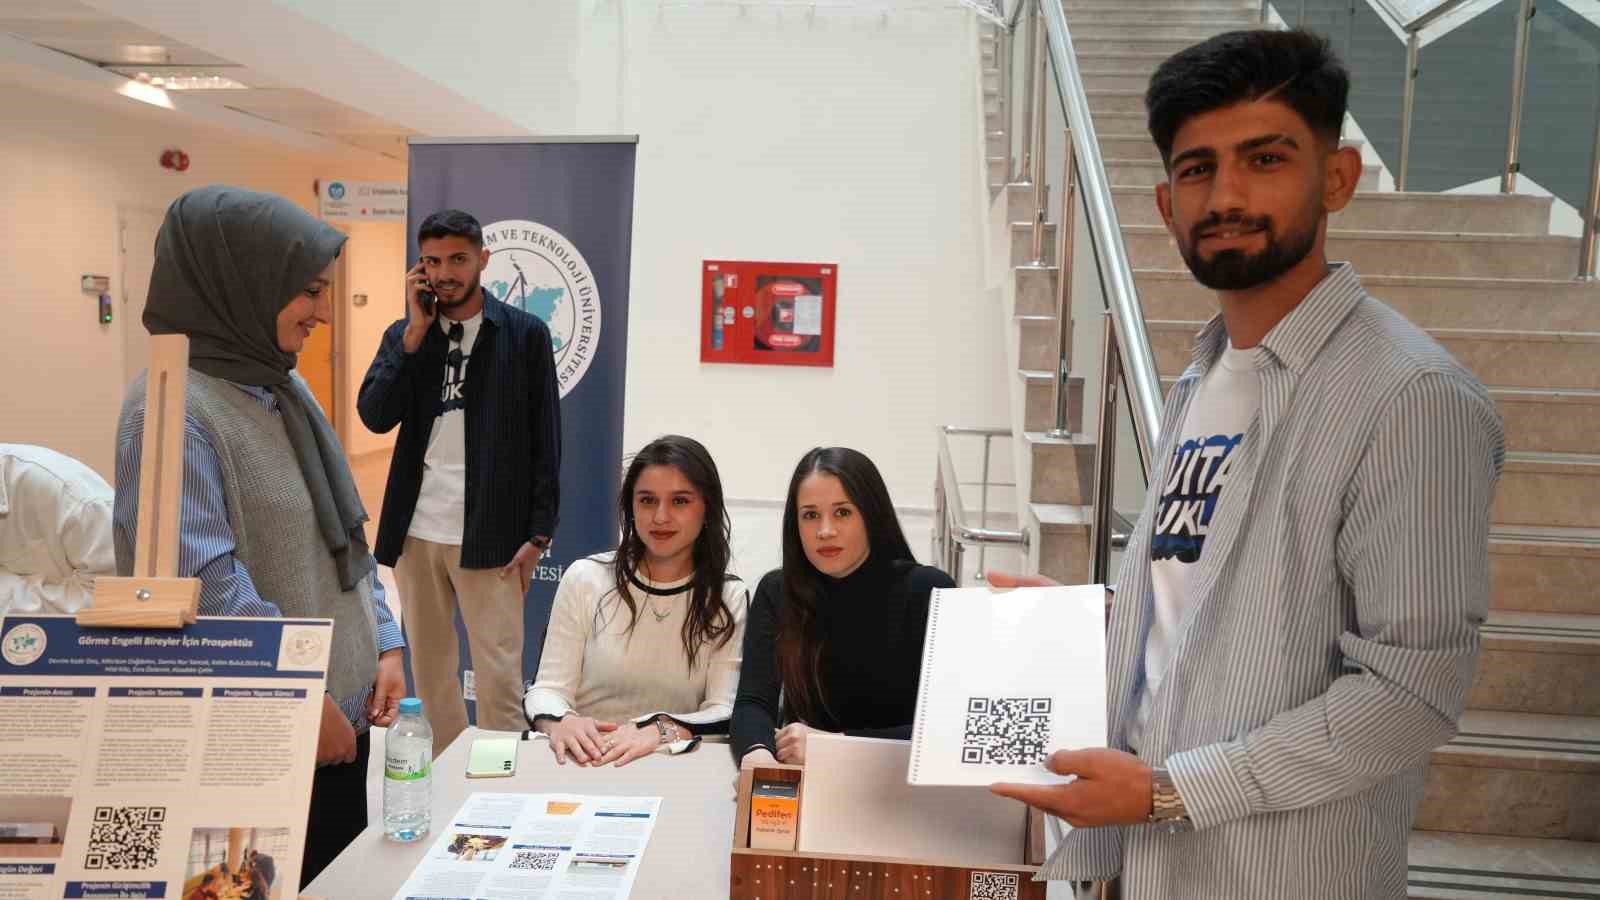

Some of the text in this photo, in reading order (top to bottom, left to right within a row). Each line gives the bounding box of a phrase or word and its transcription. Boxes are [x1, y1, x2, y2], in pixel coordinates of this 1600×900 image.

[501, 229, 518, 241] VE
[521, 230, 588, 284] TEKNOLOJİ
[558, 286, 597, 390] ÜNİVERSİTES
[78, 635, 253, 649] Görme Engelli Bireyler İçin Prospektüs
